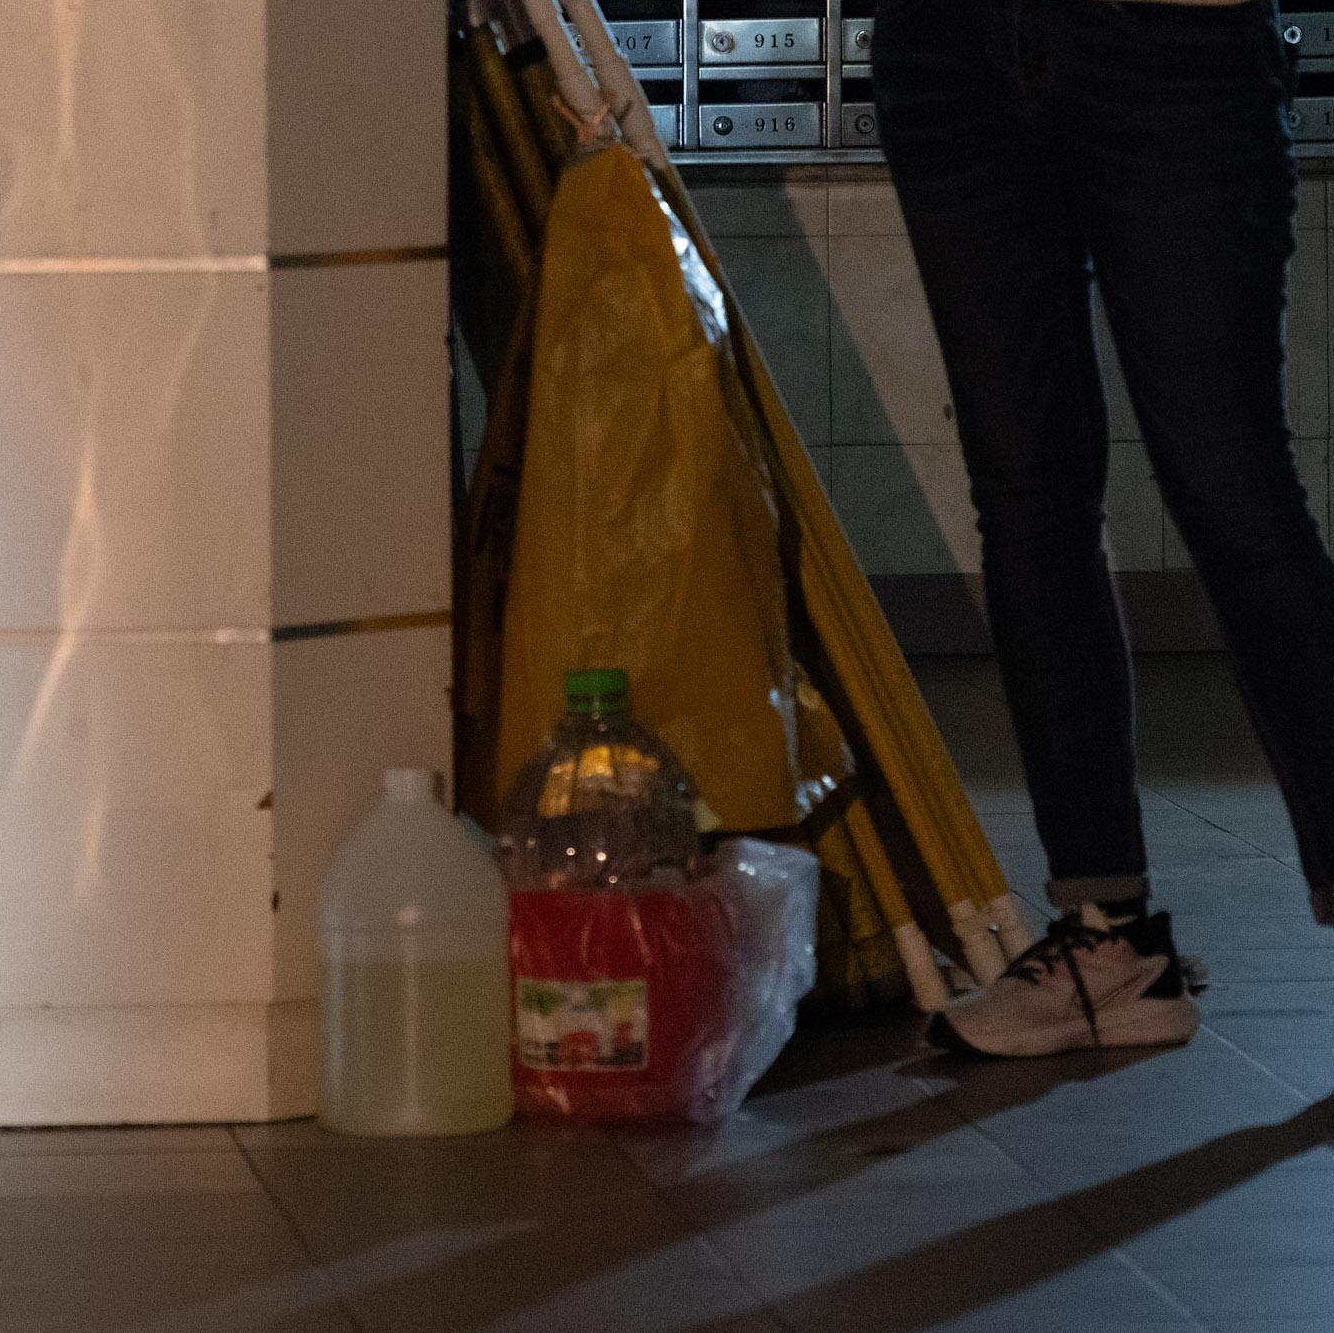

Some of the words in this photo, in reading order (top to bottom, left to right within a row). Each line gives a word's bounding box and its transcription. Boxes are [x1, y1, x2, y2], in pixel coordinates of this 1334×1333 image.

[617, 34, 652, 51] 07
[753, 32, 795, 49] 915
[754, 116, 796, 133] 916
